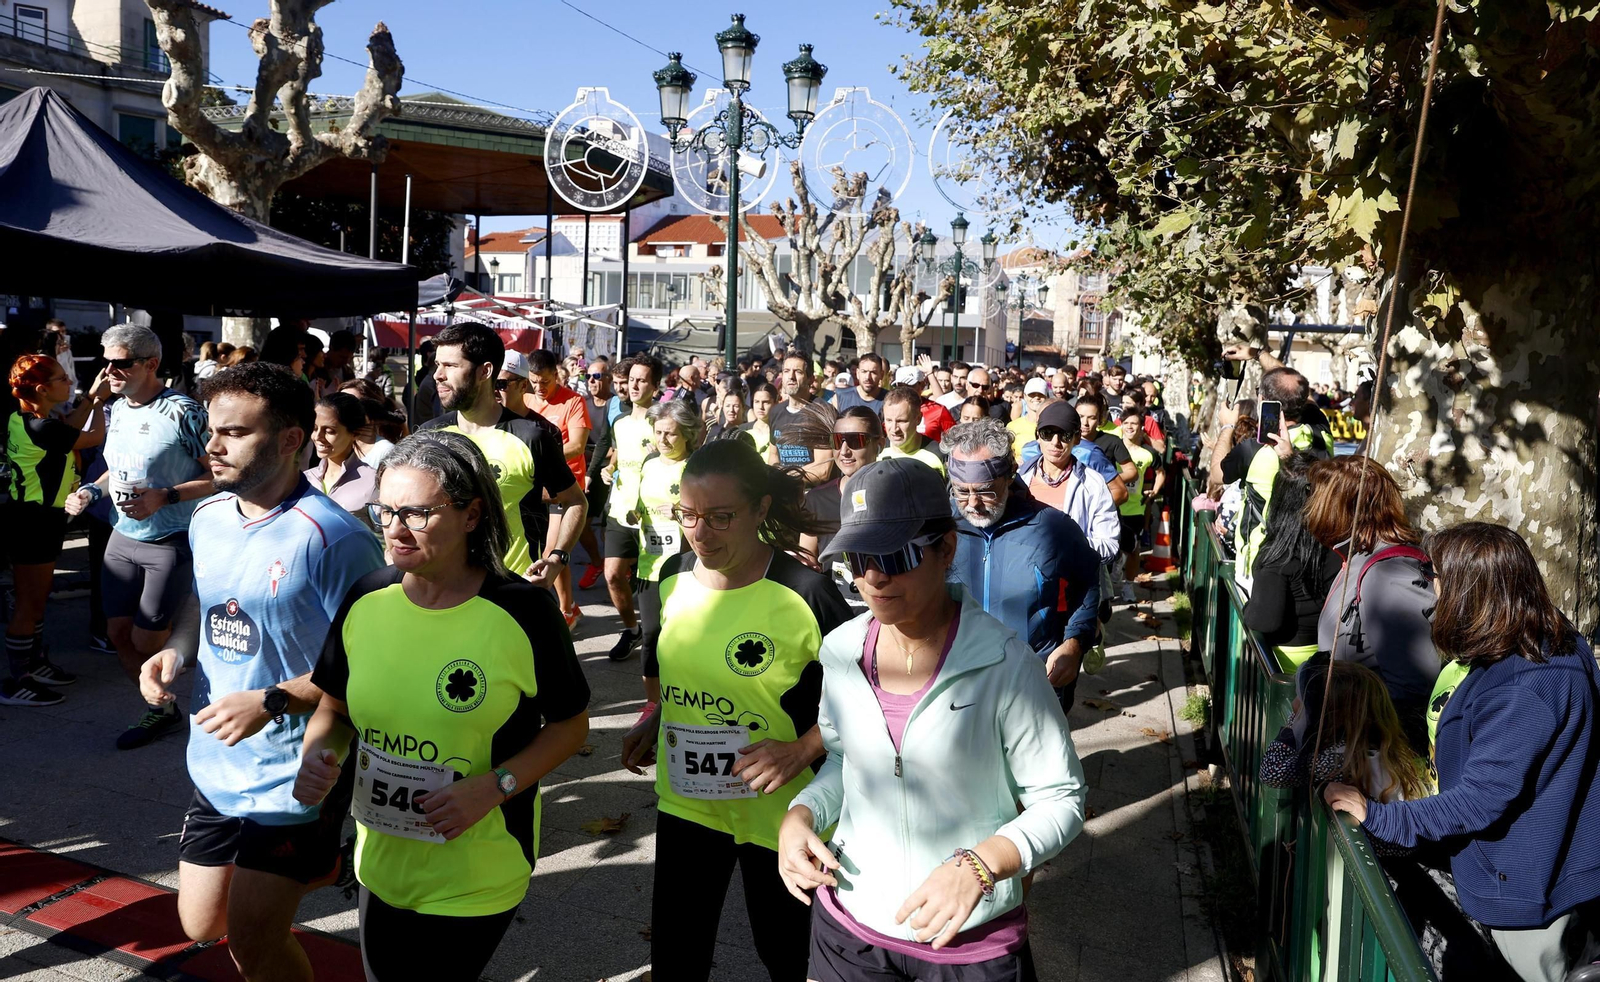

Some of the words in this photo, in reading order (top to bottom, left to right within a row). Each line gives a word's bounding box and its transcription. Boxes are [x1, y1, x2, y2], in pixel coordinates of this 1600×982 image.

[650, 534, 674, 546] 519
[210, 613, 251, 637] Estrella
[212, 629, 248, 652] Galicia
[660, 684, 735, 715] VEMPO
[358, 727, 438, 762] VEMPO
[684, 750, 736, 776] 547
